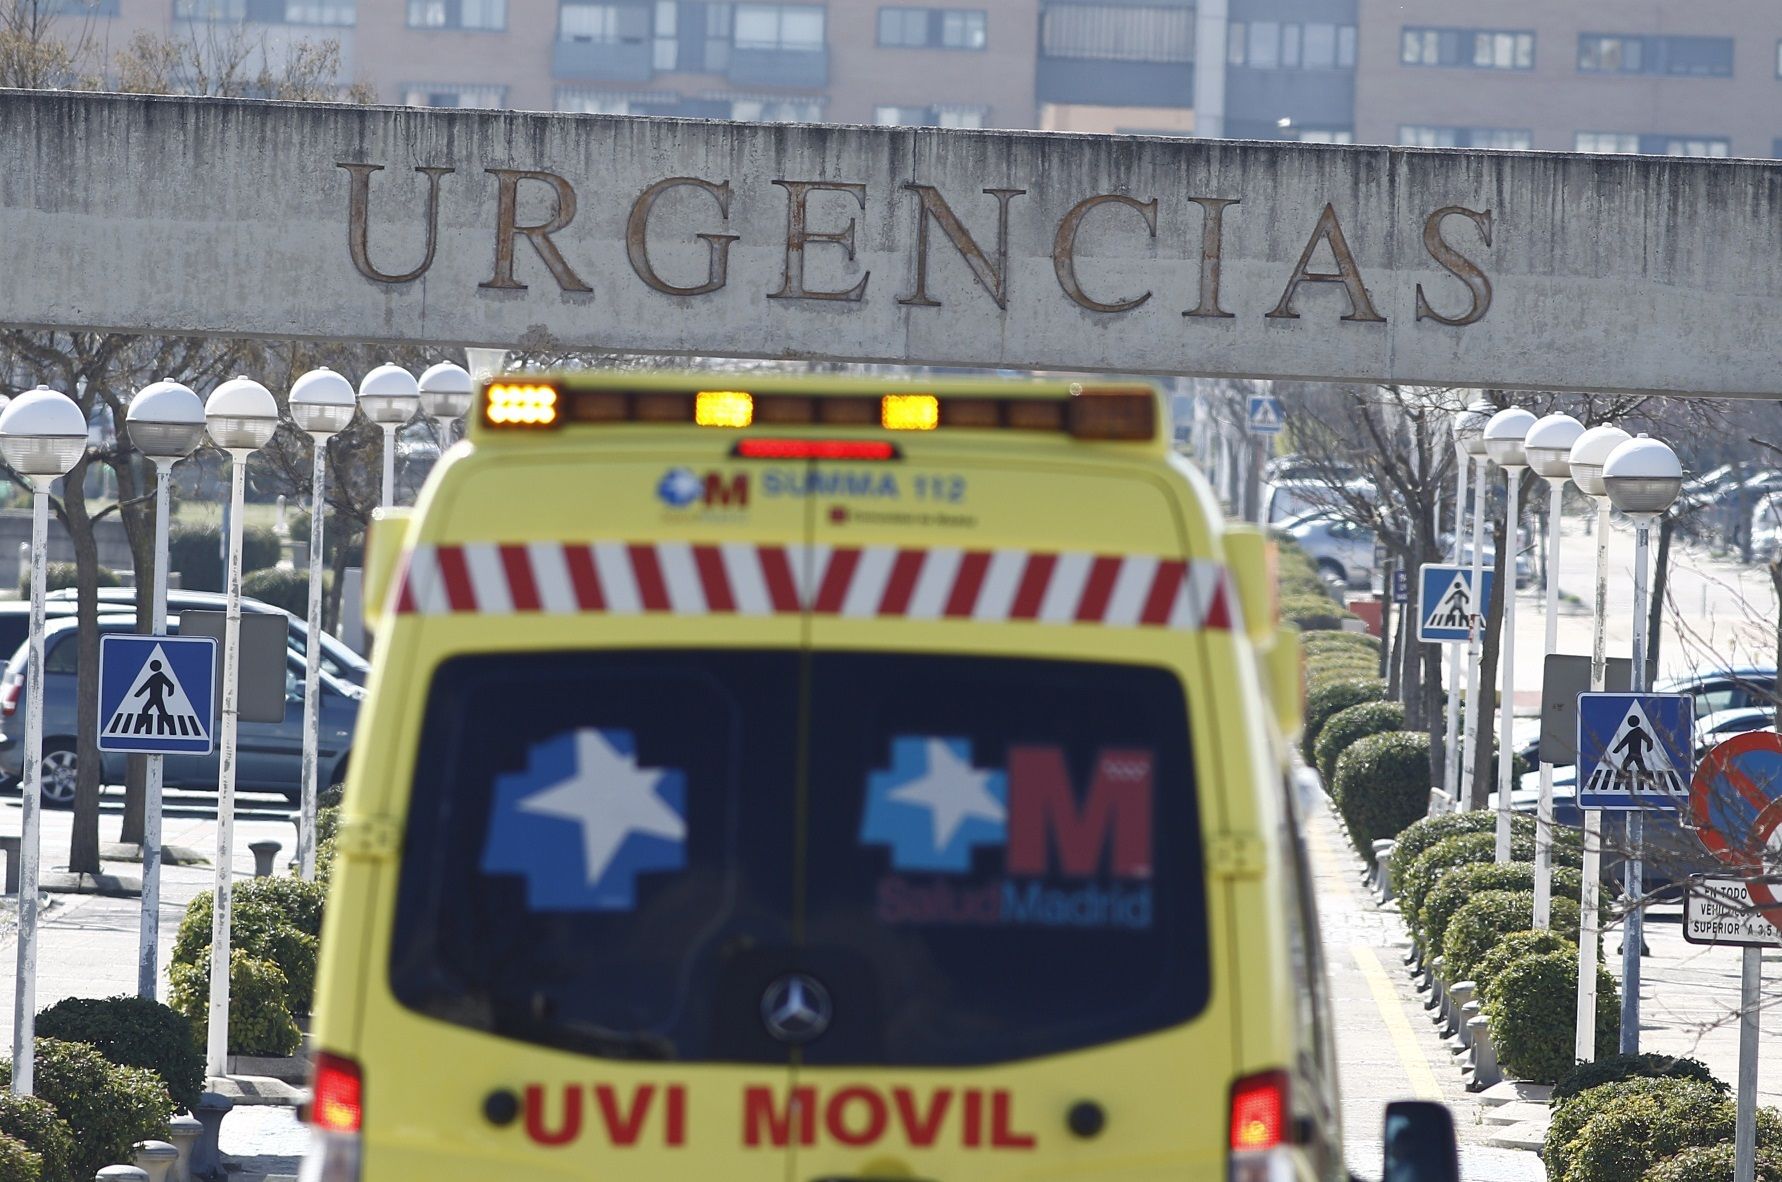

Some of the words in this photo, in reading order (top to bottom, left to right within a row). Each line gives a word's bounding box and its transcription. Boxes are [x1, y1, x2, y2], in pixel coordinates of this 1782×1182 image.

[337, 162, 1492, 326] URGENCIAS
[703, 471, 750, 507] M
[761, 469, 899, 499] SUMMA
[913, 474, 966, 504] 112
[1009, 746, 1152, 876] M
[1720, 887, 1747, 899] TODO
[1694, 921, 1740, 935] SUPERIOR
[524, 1083, 686, 1147] UVI
[741, 1084, 1037, 1149] MOVIL
